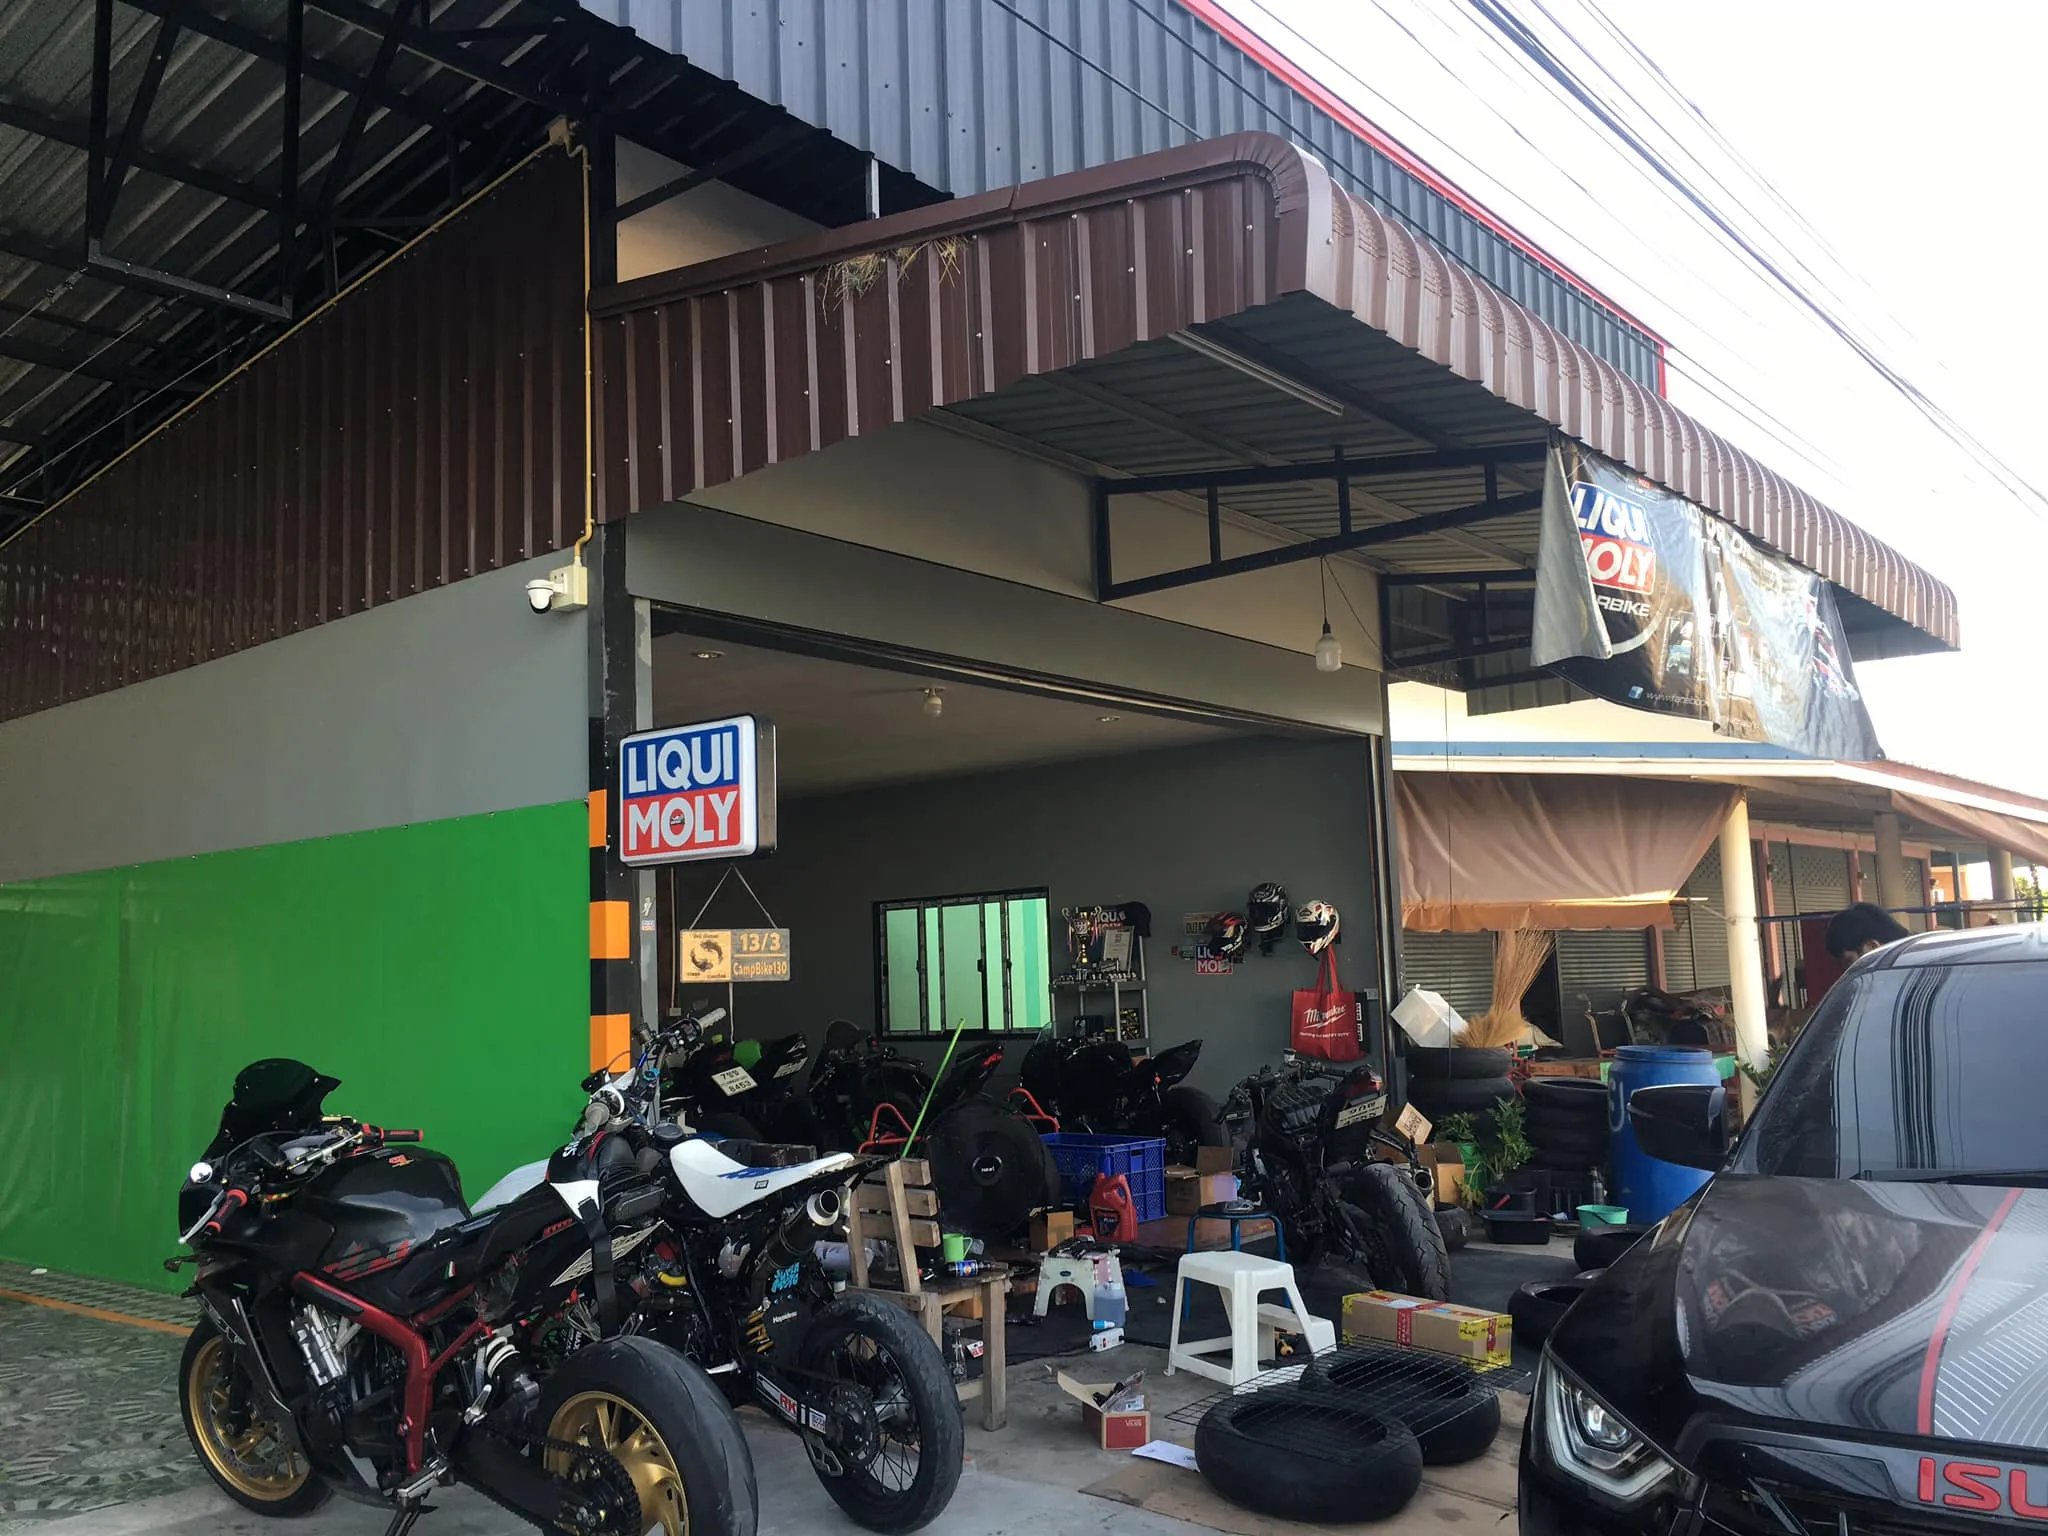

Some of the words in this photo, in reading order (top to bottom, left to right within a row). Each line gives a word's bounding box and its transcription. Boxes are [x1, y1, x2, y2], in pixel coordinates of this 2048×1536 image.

[628, 731, 733, 794] LIQUI
[628, 790, 739, 851] MOLY
[740, 932, 781, 952] 13/3
